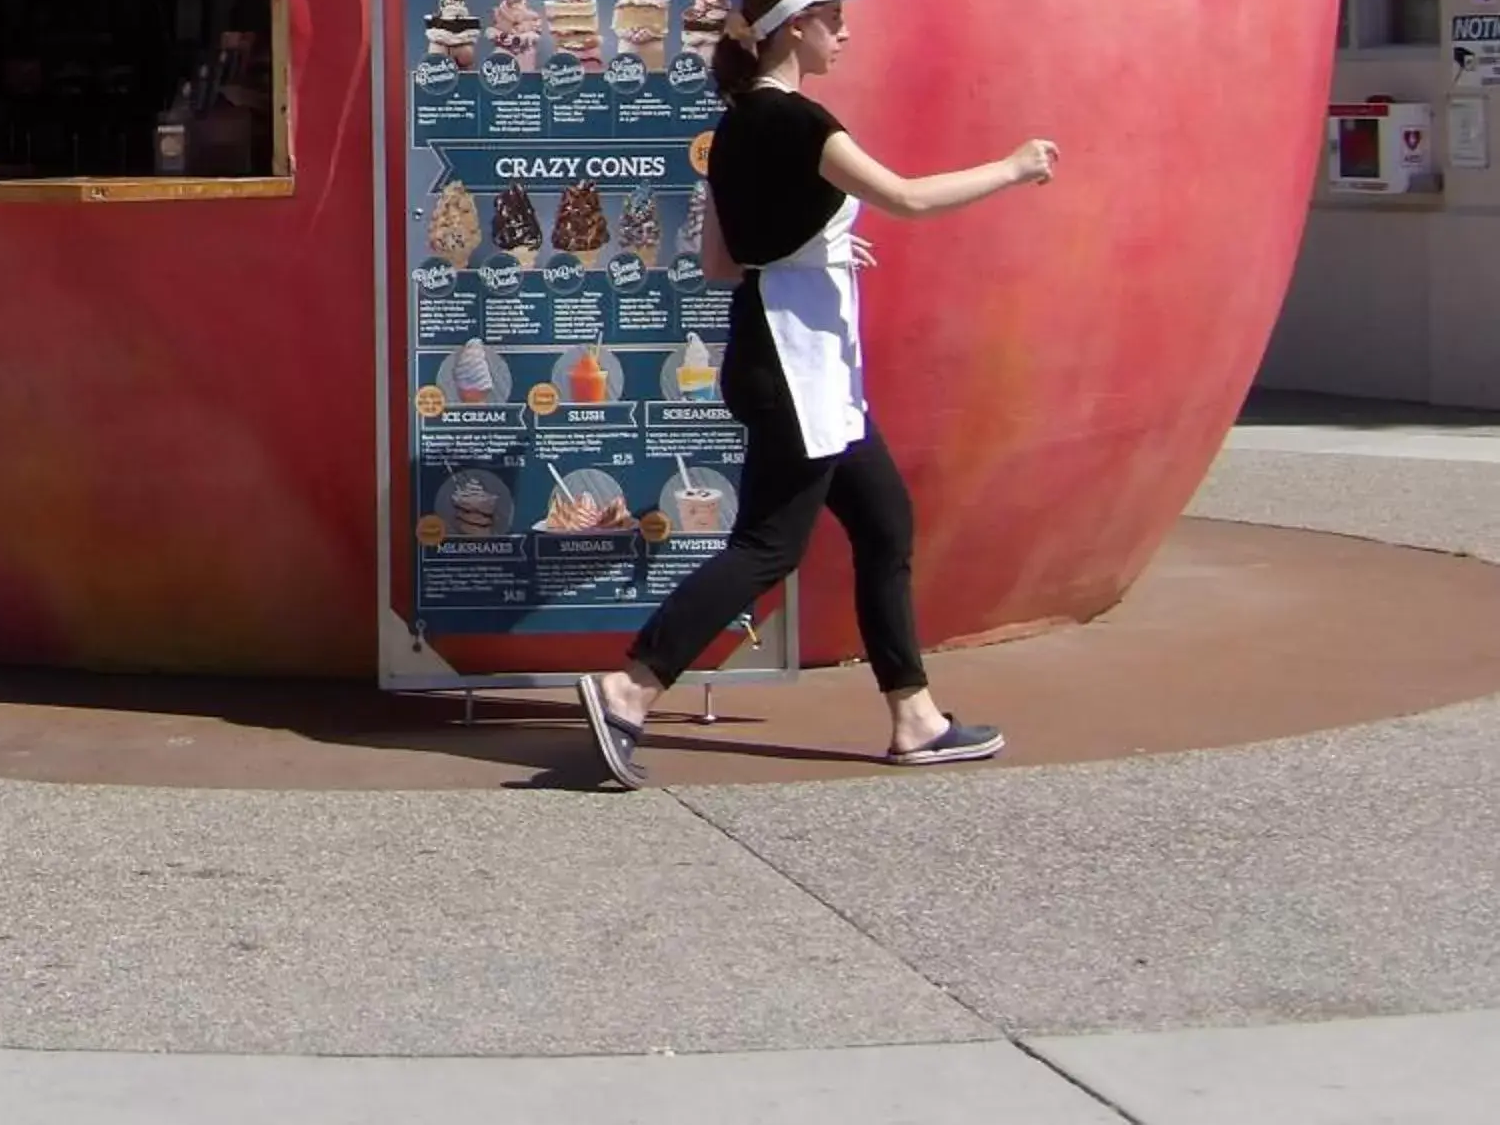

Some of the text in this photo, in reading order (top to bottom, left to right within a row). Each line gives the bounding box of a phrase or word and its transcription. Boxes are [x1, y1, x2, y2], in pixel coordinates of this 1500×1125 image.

[495, 156, 666, 178] CRAZY CONES
[462, 410, 507, 423] CREAM
[567, 409, 605, 423] SLUSH
[437, 540, 514, 555] MILKSHAKES
[559, 539, 616, 553] SUNDAES
[669, 538, 727, 551] TWISTERS
